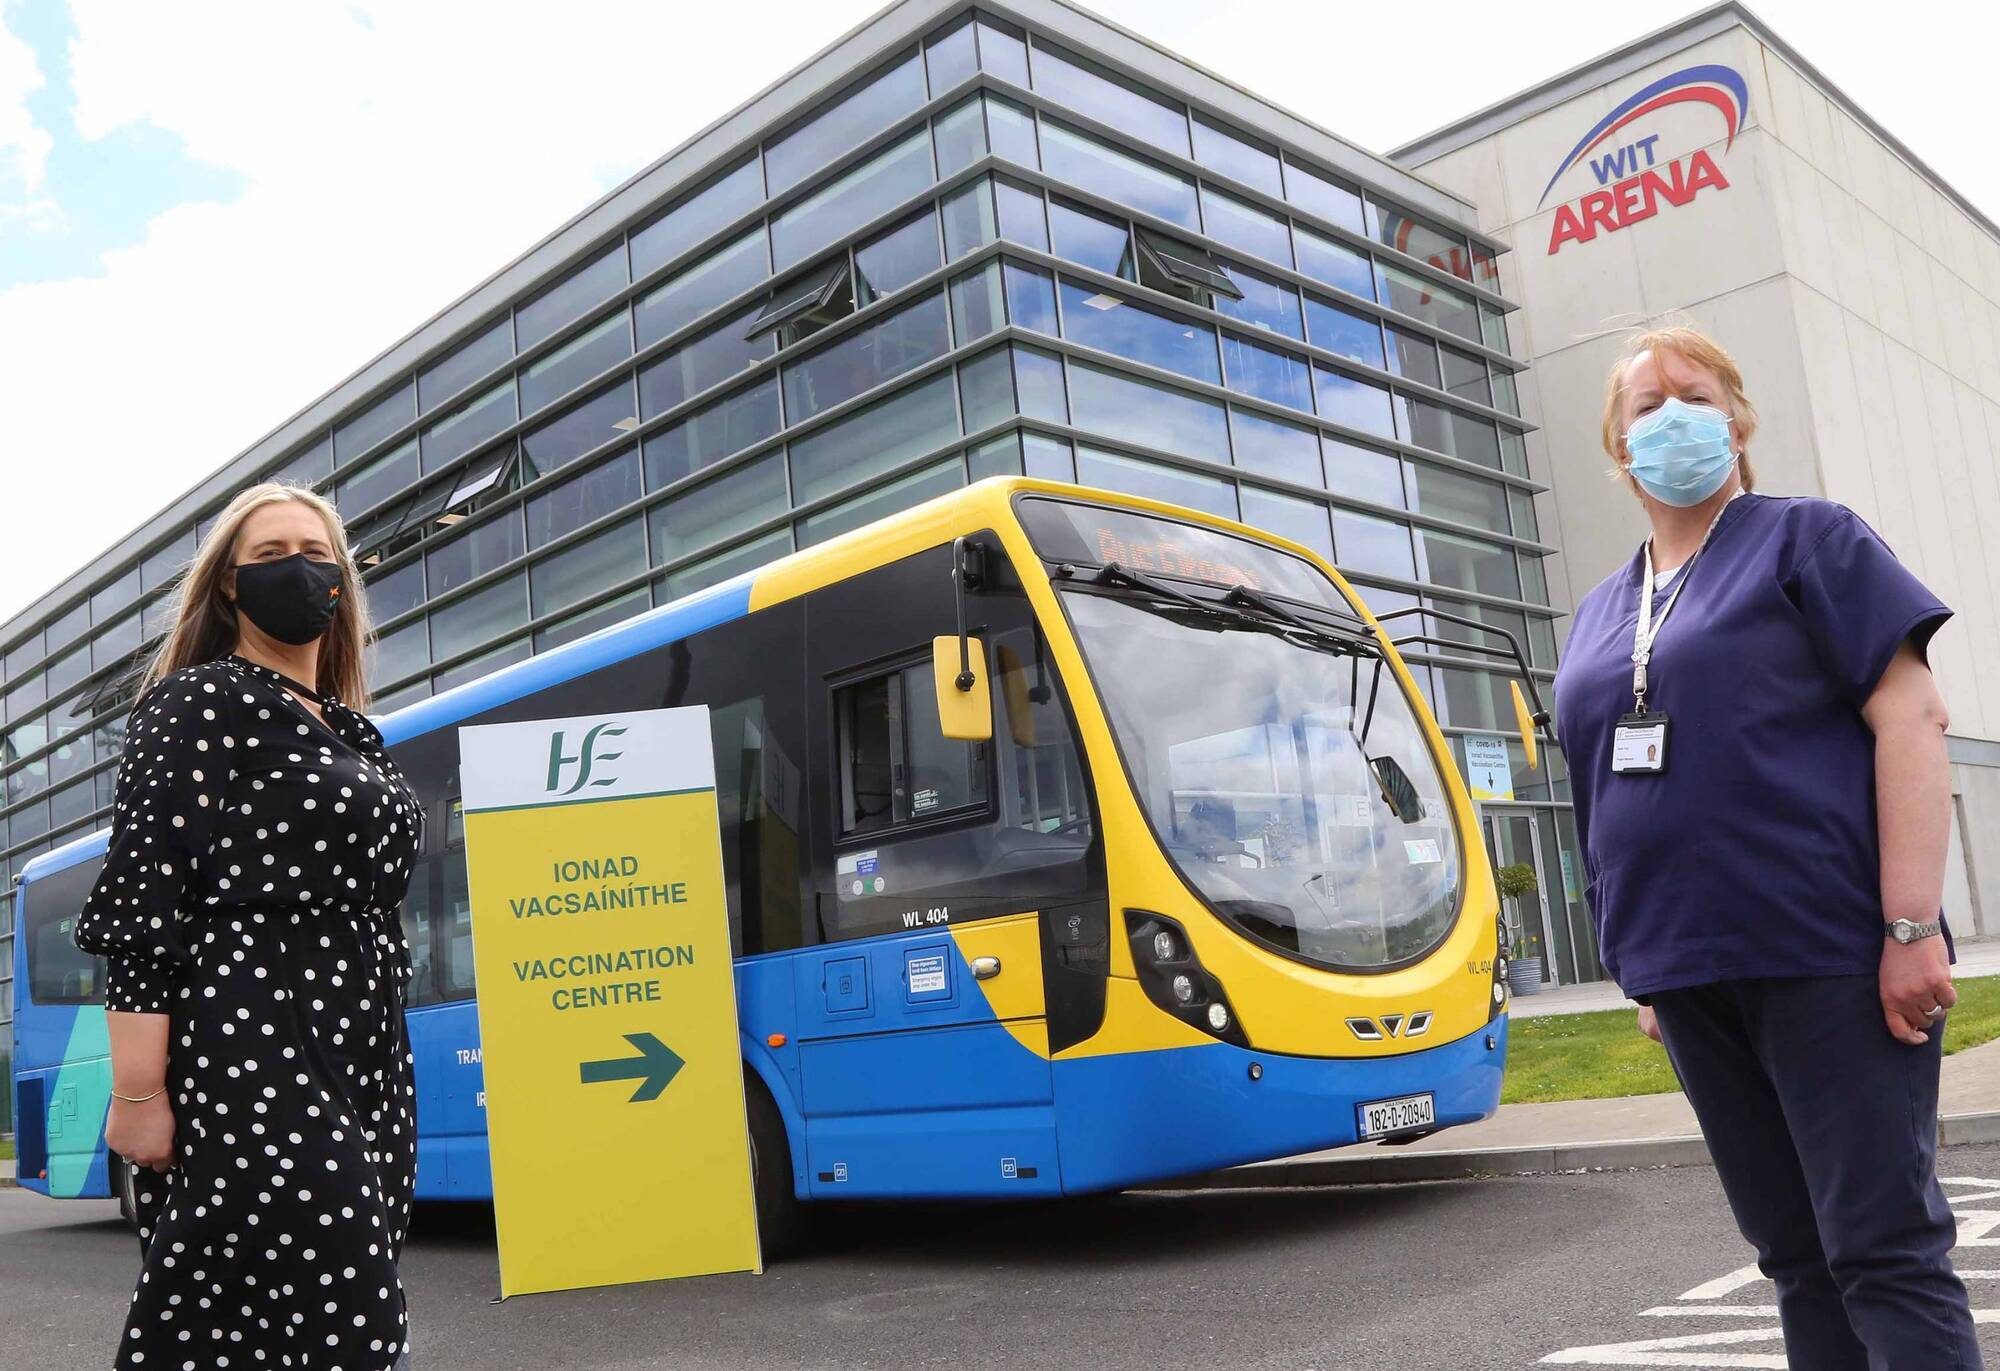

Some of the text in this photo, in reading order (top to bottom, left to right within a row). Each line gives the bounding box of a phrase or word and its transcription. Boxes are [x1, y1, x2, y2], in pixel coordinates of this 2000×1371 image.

[1589, 133, 1659, 185] WIT
[1547, 149, 1730, 256] ARENA
[545, 721, 628, 796] HSE
[553, 856, 638, 882] IONAD
[510, 882, 687, 919] VACSAÍNÍTHE
[902, 906, 949, 928] WL 404
[513, 945, 694, 982] VACCINATION
[1466, 960, 1480, 975] WL
[552, 981, 661, 1010] CENTRE
[1369, 1101, 1431, 1131] 182-D-20940
